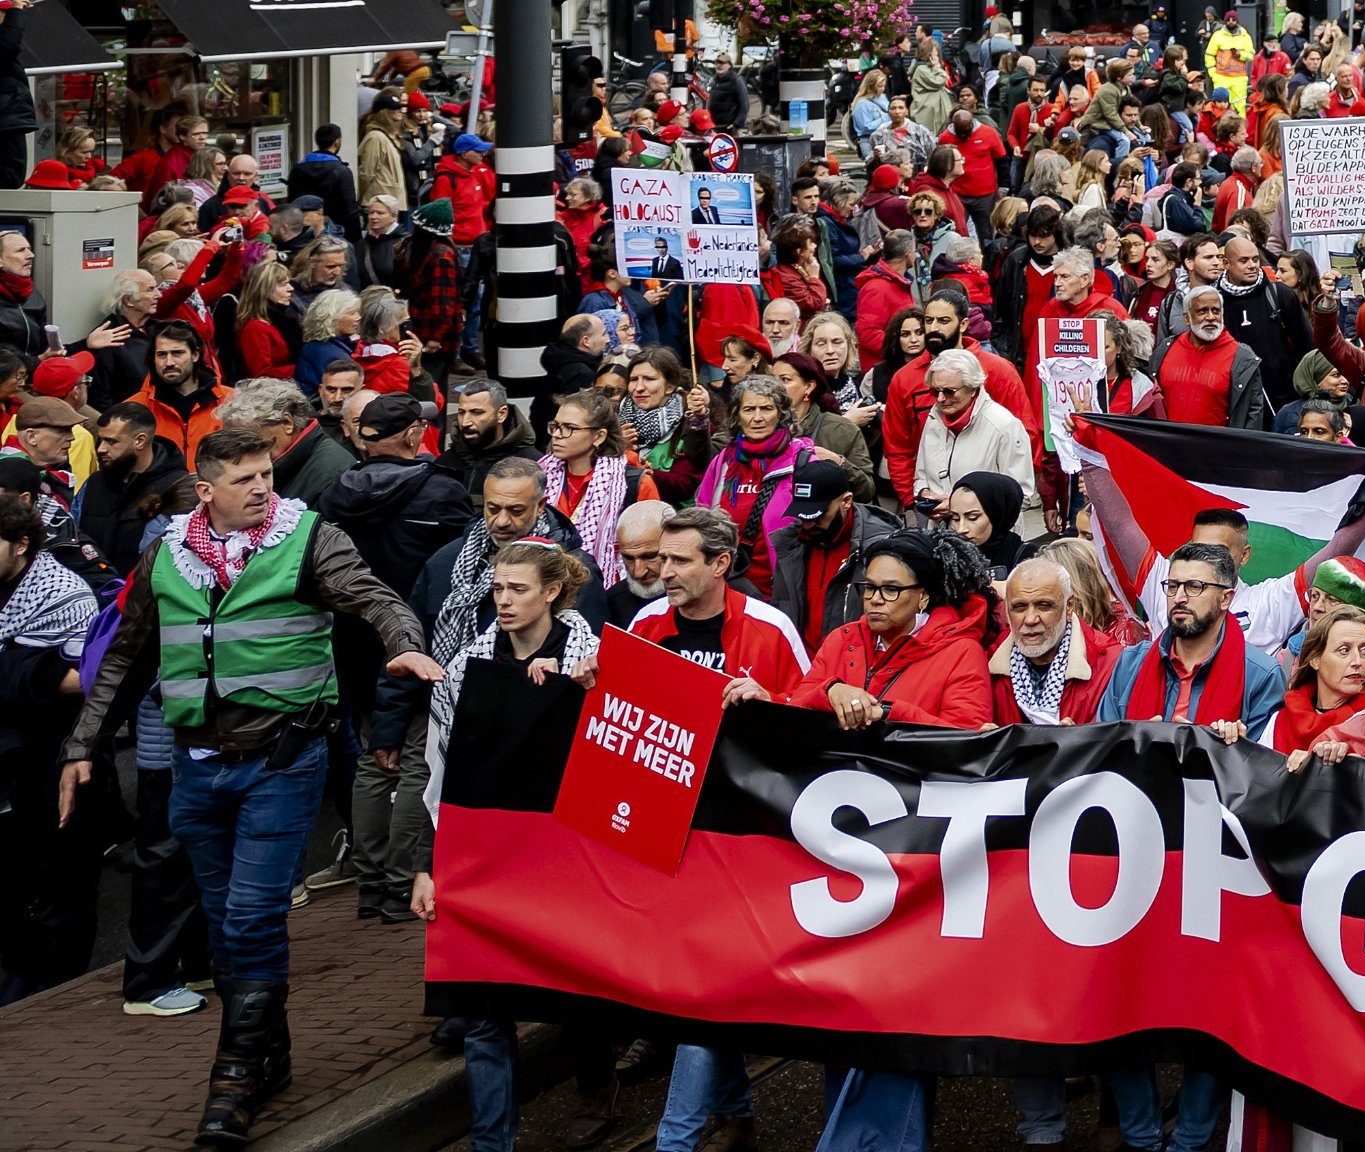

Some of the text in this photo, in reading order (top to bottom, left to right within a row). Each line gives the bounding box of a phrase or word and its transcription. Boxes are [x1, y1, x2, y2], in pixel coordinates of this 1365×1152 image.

[1289, 127, 1300, 139] IS
[1302, 127, 1318, 139] DE
[1289, 139, 1305, 150] OP
[1314, 150, 1338, 161] ZEG
[620, 177, 672, 196] GAZA
[1295, 186, 1314, 196] ALS
[614, 201, 682, 224] HOLOCAUST
[1291, 209, 1303, 218] EN
[1305, 208, 1337, 218] TRUMP
[1338, 208, 1360, 217] ZEGT
[1292, 220, 1309, 230] DAT
[1309, 219, 1335, 229] GAZA
[711, 232, 759, 252] Nederlandse
[1062, 320, 1080, 328] STOP
[1059, 331, 1084, 340] KILLING
[1054, 344, 1090, 353] CHILDEREN
[603, 692, 695, 757] WIJ ZIJN
[585, 716, 695, 788] MET MEER
[612, 814, 630, 827] OXFAM
[789, 769, 1275, 948] STOP
